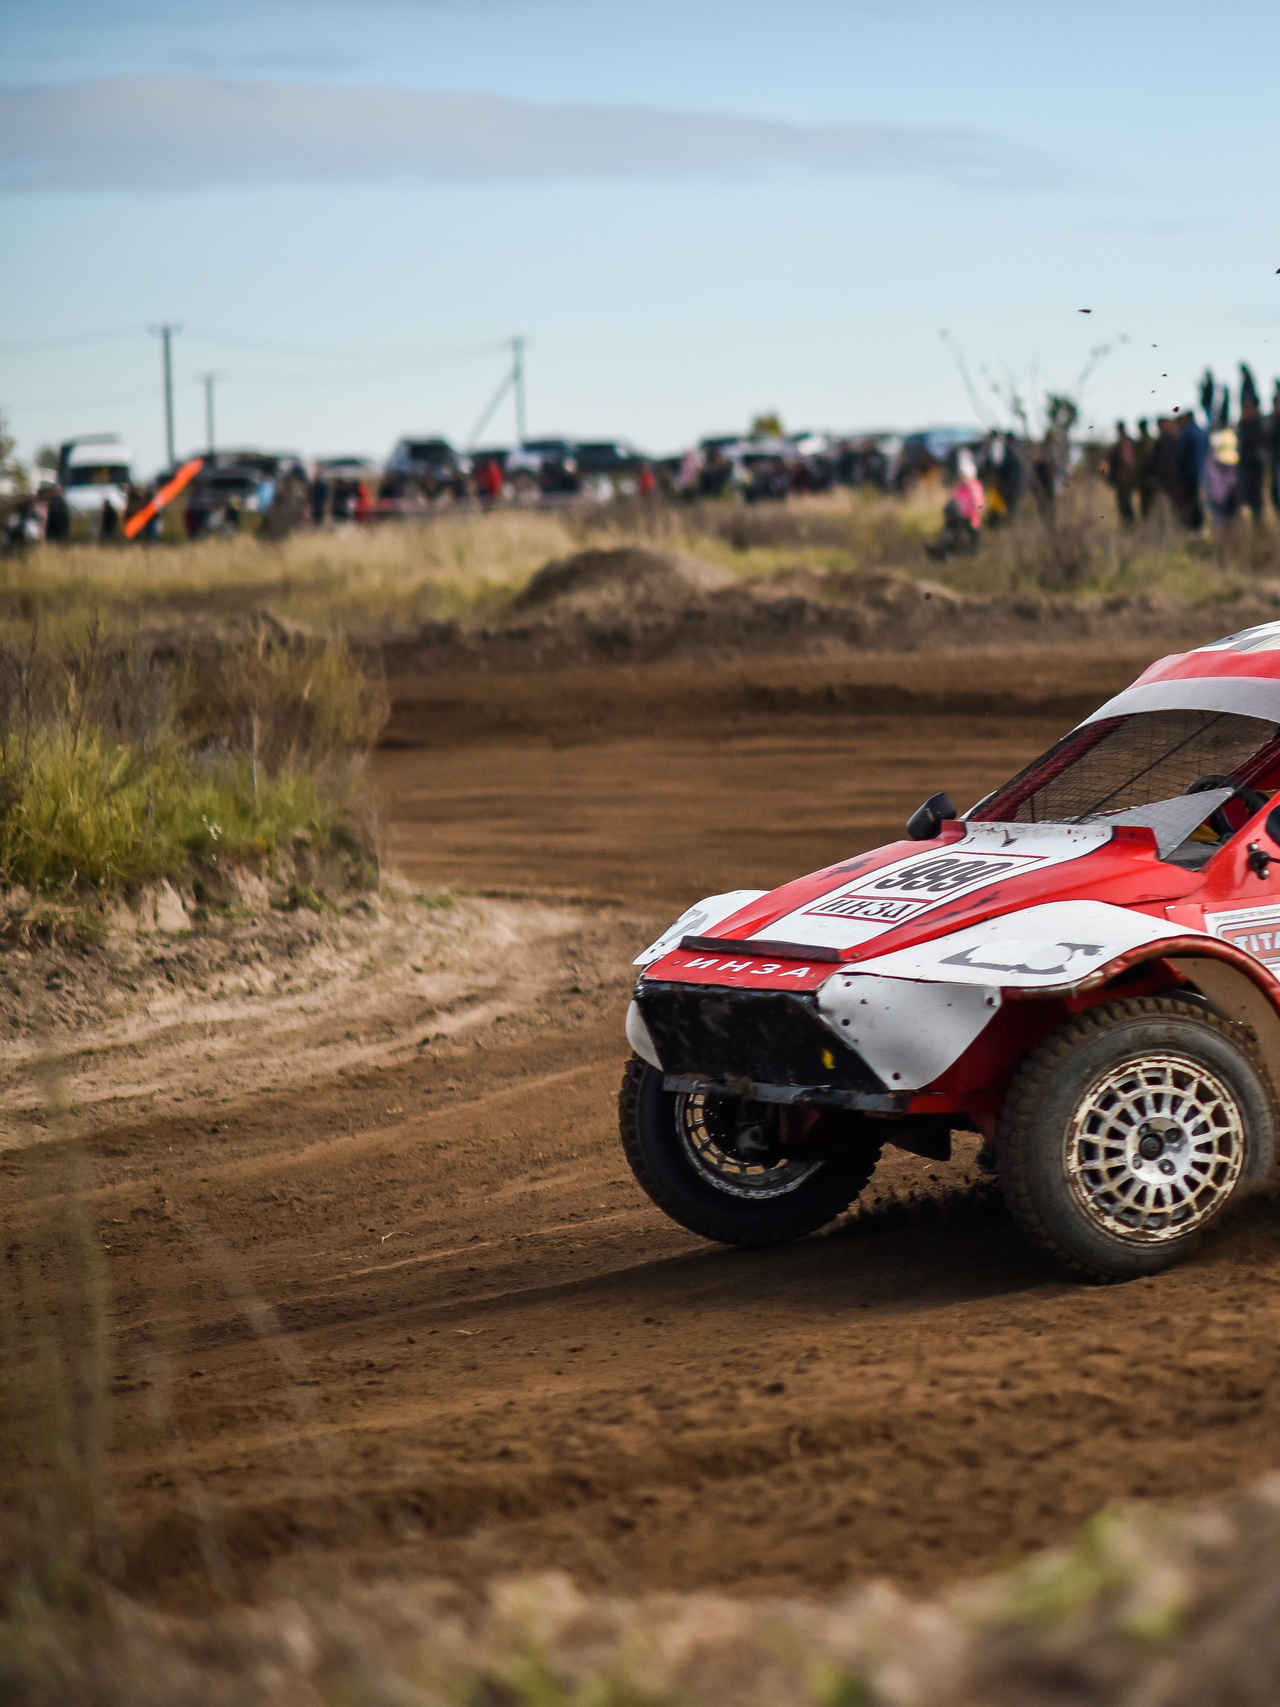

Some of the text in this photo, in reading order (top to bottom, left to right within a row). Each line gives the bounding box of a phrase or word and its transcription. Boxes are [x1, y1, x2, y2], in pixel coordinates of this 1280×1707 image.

[874, 858, 1015, 892] 999
[818, 898, 913, 920] ИНЗА
[682, 957, 812, 978] ИНЗА
